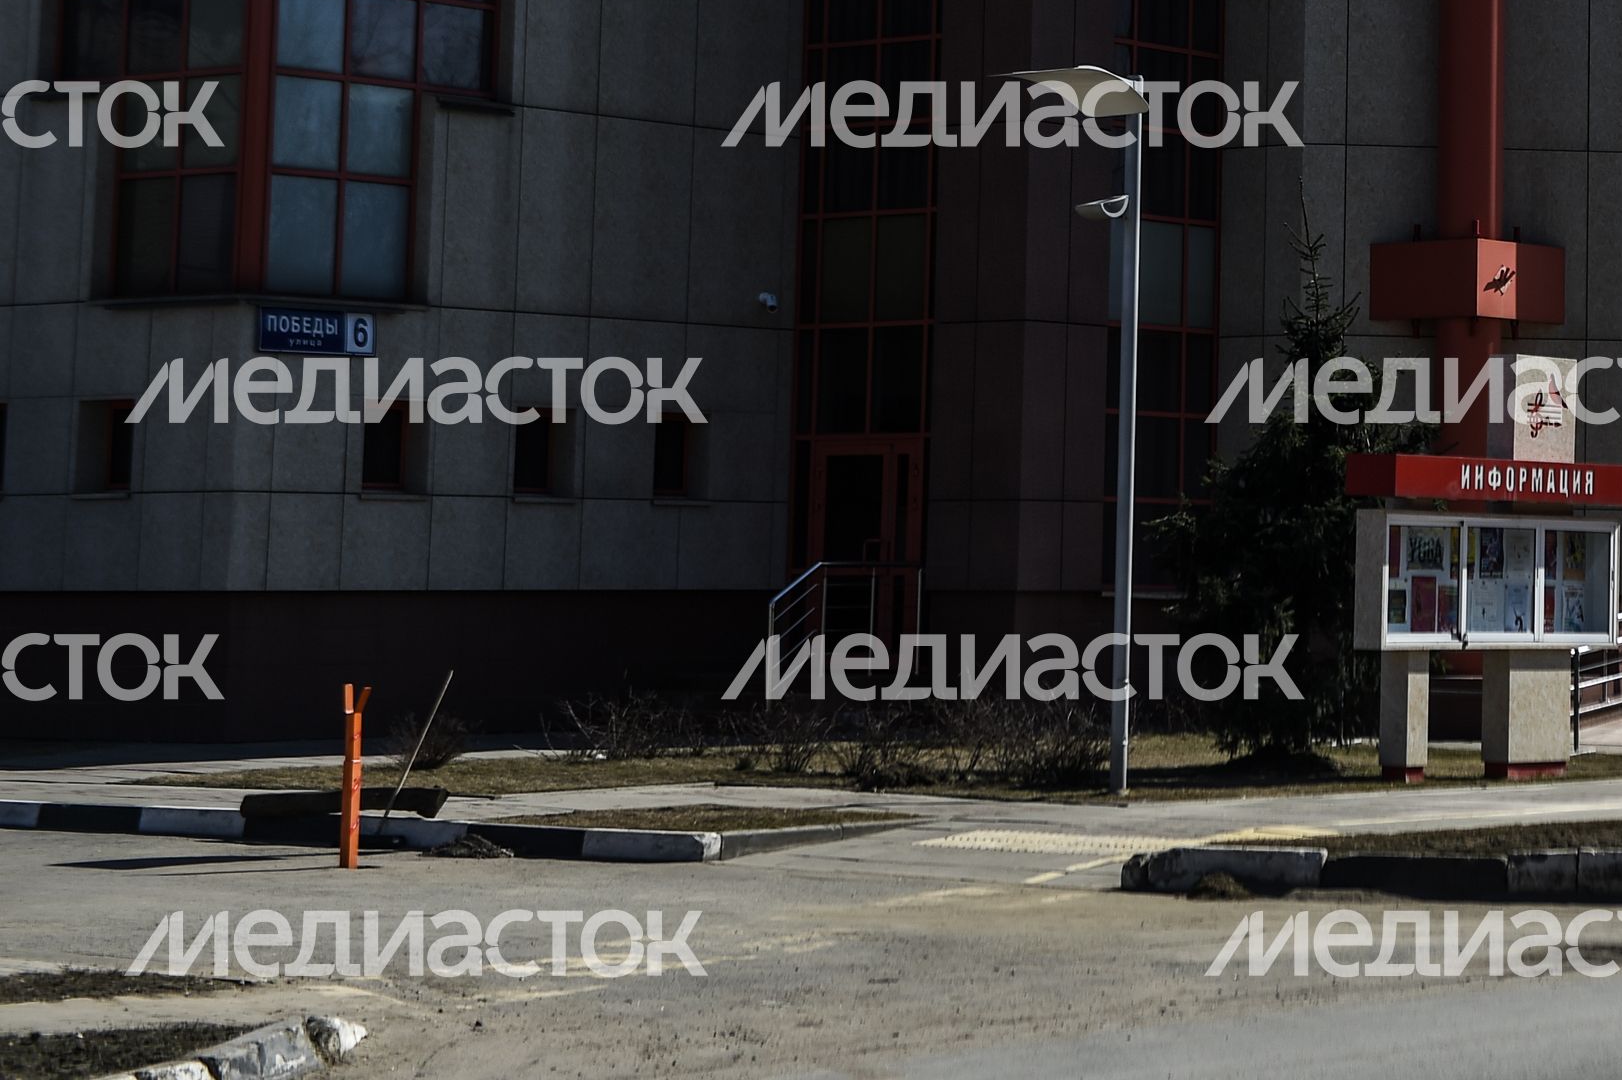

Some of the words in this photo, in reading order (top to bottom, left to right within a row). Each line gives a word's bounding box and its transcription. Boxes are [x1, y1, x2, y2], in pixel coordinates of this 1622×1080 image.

[267, 315, 339, 338] ПОБЕДЫ
[353, 317, 369, 348] 6
[289, 338, 323, 348] улица
[1461, 464, 1594, 498] ИНФОРМАЦИЯ
